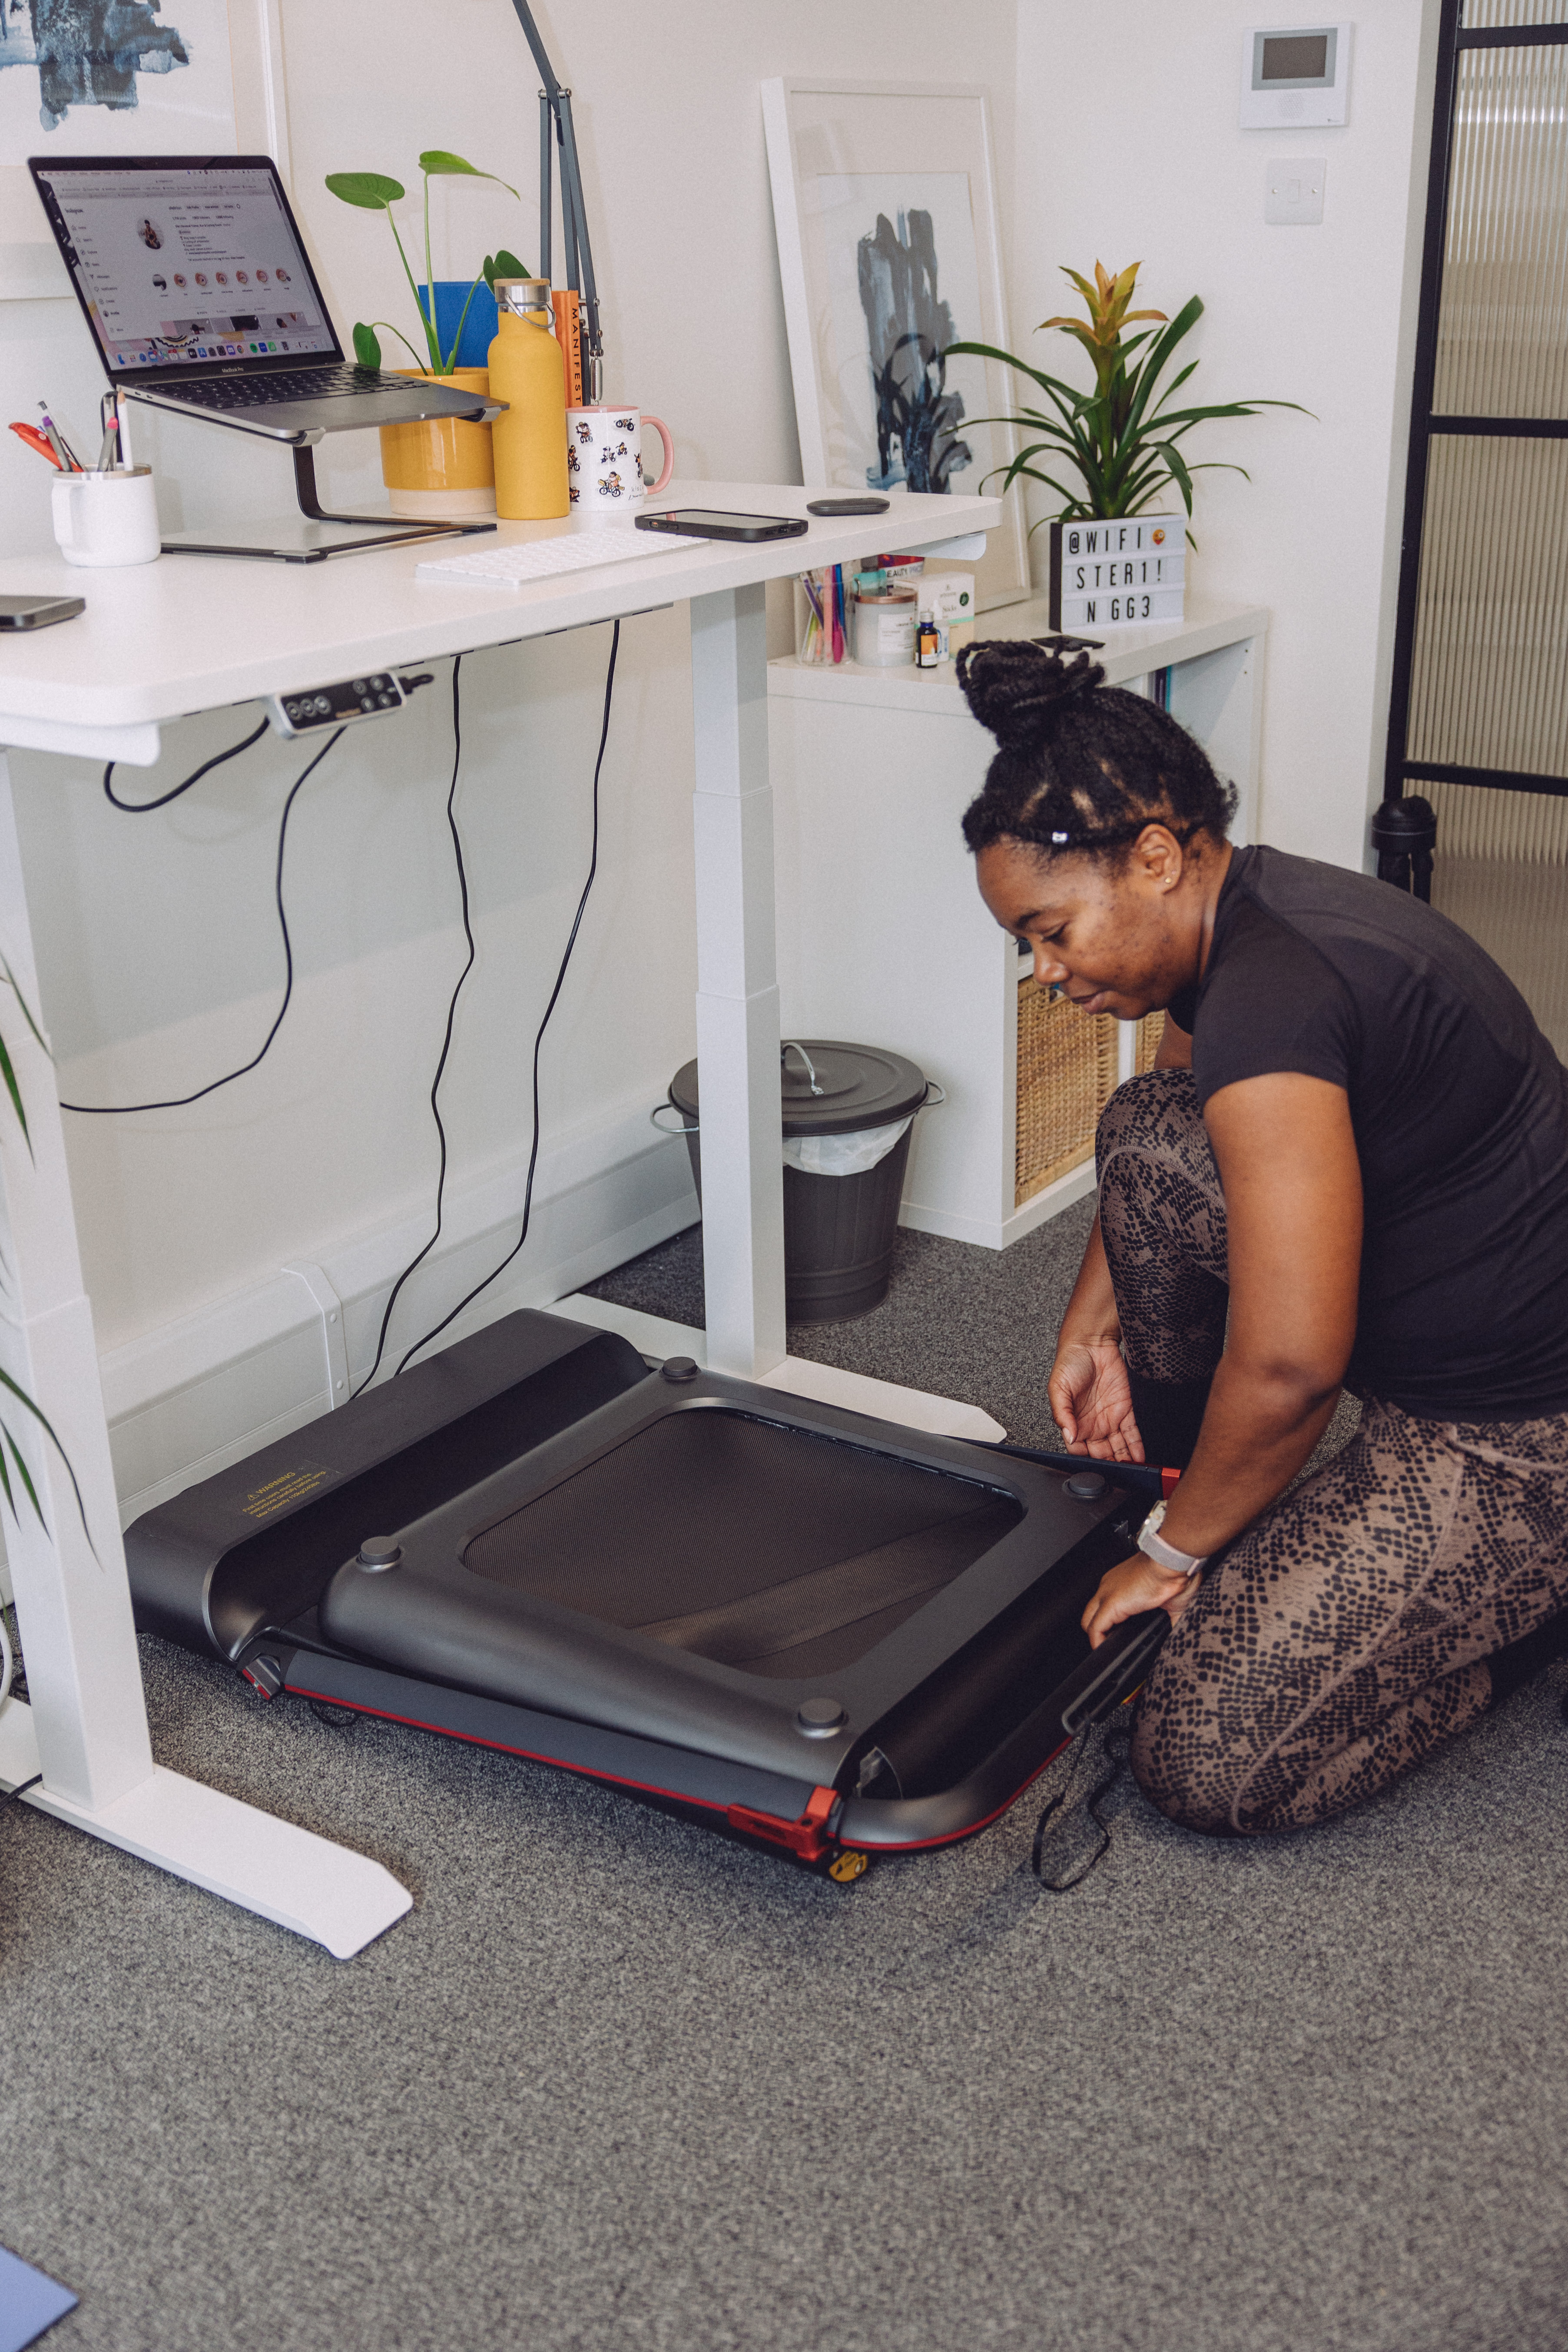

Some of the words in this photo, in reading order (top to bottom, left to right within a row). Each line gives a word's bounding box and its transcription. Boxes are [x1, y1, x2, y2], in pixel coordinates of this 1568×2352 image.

[572, 308, 582, 402] MANIFEST
[886, 567, 908, 577] EAUTY
[255, 1472, 295, 1494] WARNING
[276, 1487, 297, 1499] carefully
[295, 1479, 312, 1488] before
[268, 1498, 290, 1511] Capacity
